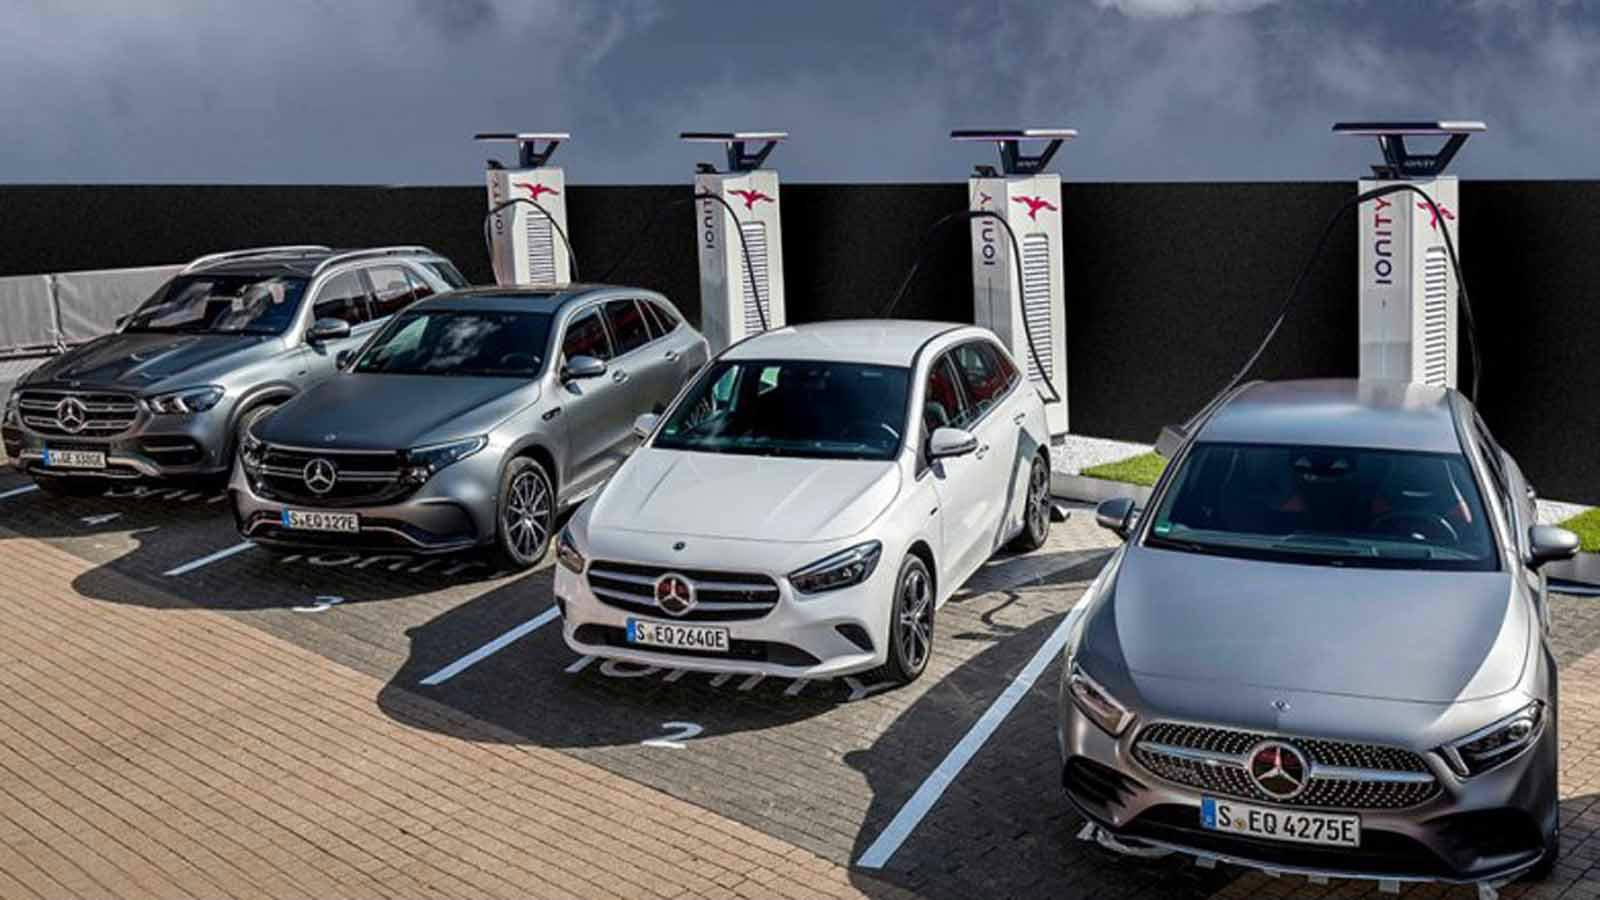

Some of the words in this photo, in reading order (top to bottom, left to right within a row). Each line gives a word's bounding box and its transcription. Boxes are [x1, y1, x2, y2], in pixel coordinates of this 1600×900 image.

[1375, 196, 1392, 285] IONITY
[290, 512, 299, 526] S
[637, 624, 645, 641] S
[655, 626, 674, 645] EQ
[641, 722, 705, 749] 2
[1218, 805, 1231, 827] S
[1249, 810, 1277, 835] EQ
[1283, 815, 1356, 843] 4275E
